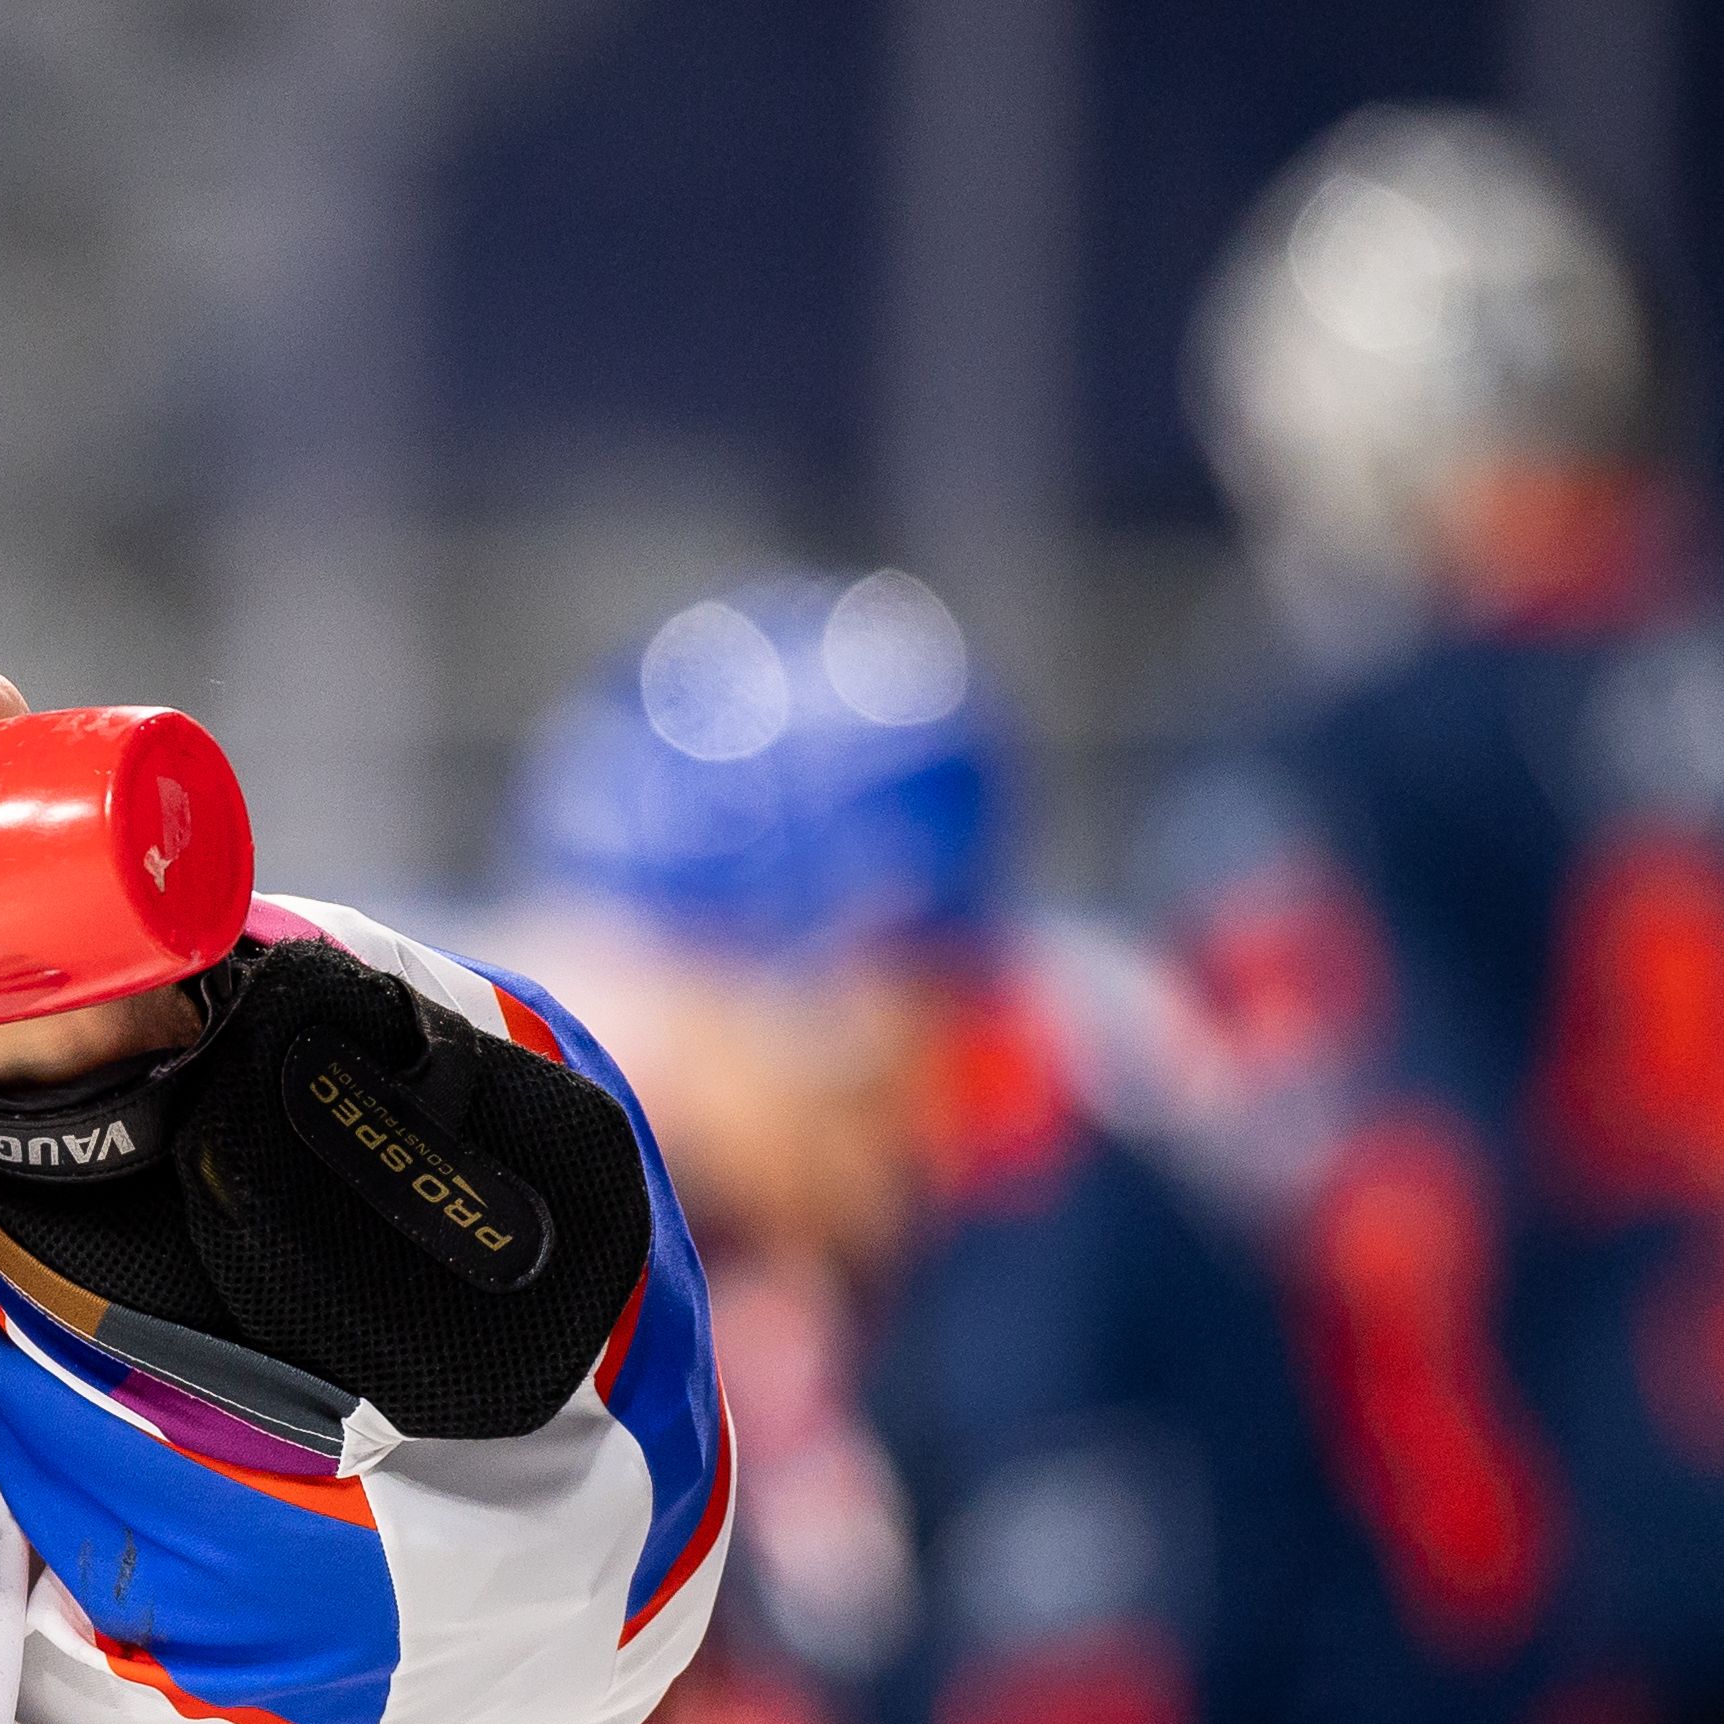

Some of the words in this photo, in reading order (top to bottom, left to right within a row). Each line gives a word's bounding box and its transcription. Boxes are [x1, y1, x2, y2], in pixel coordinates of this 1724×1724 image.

[309, 1074, 414, 1173] SPEC
[328, 1061, 454, 1176] CONSTRUCTION
[412, 1173, 514, 1251] PRO
